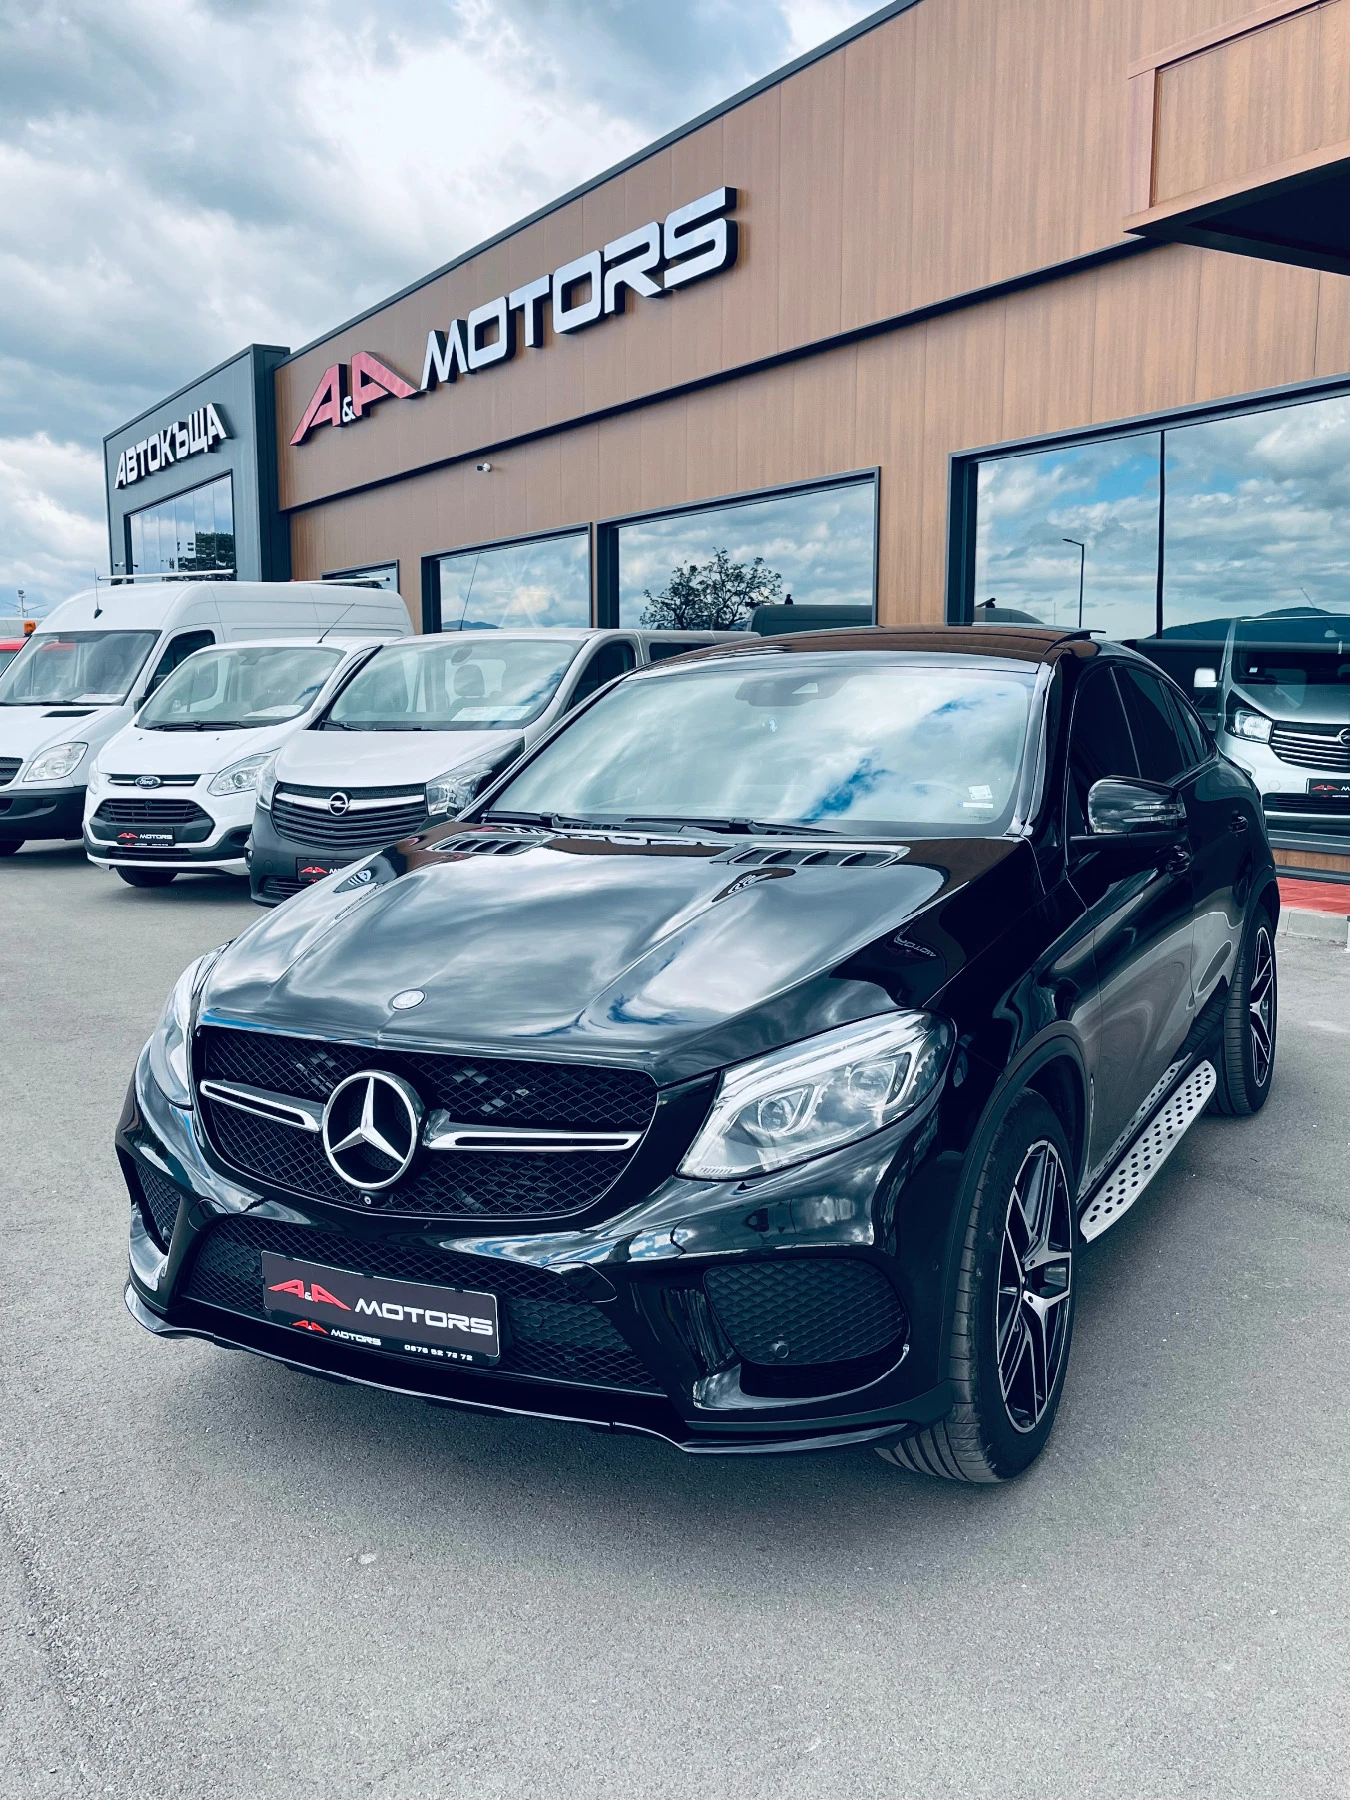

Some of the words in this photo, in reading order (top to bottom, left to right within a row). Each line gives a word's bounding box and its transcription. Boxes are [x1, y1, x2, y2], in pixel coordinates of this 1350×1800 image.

[289, 351, 418, 446] A&A
[420, 186, 737, 391] MOTORS
[114, 402, 228, 490] АВТОКЪЩА
[268, 1279, 352, 1312] A&A
[355, 1297, 494, 1337] MOTORS
[331, 1328, 382, 1347] MOTORS
